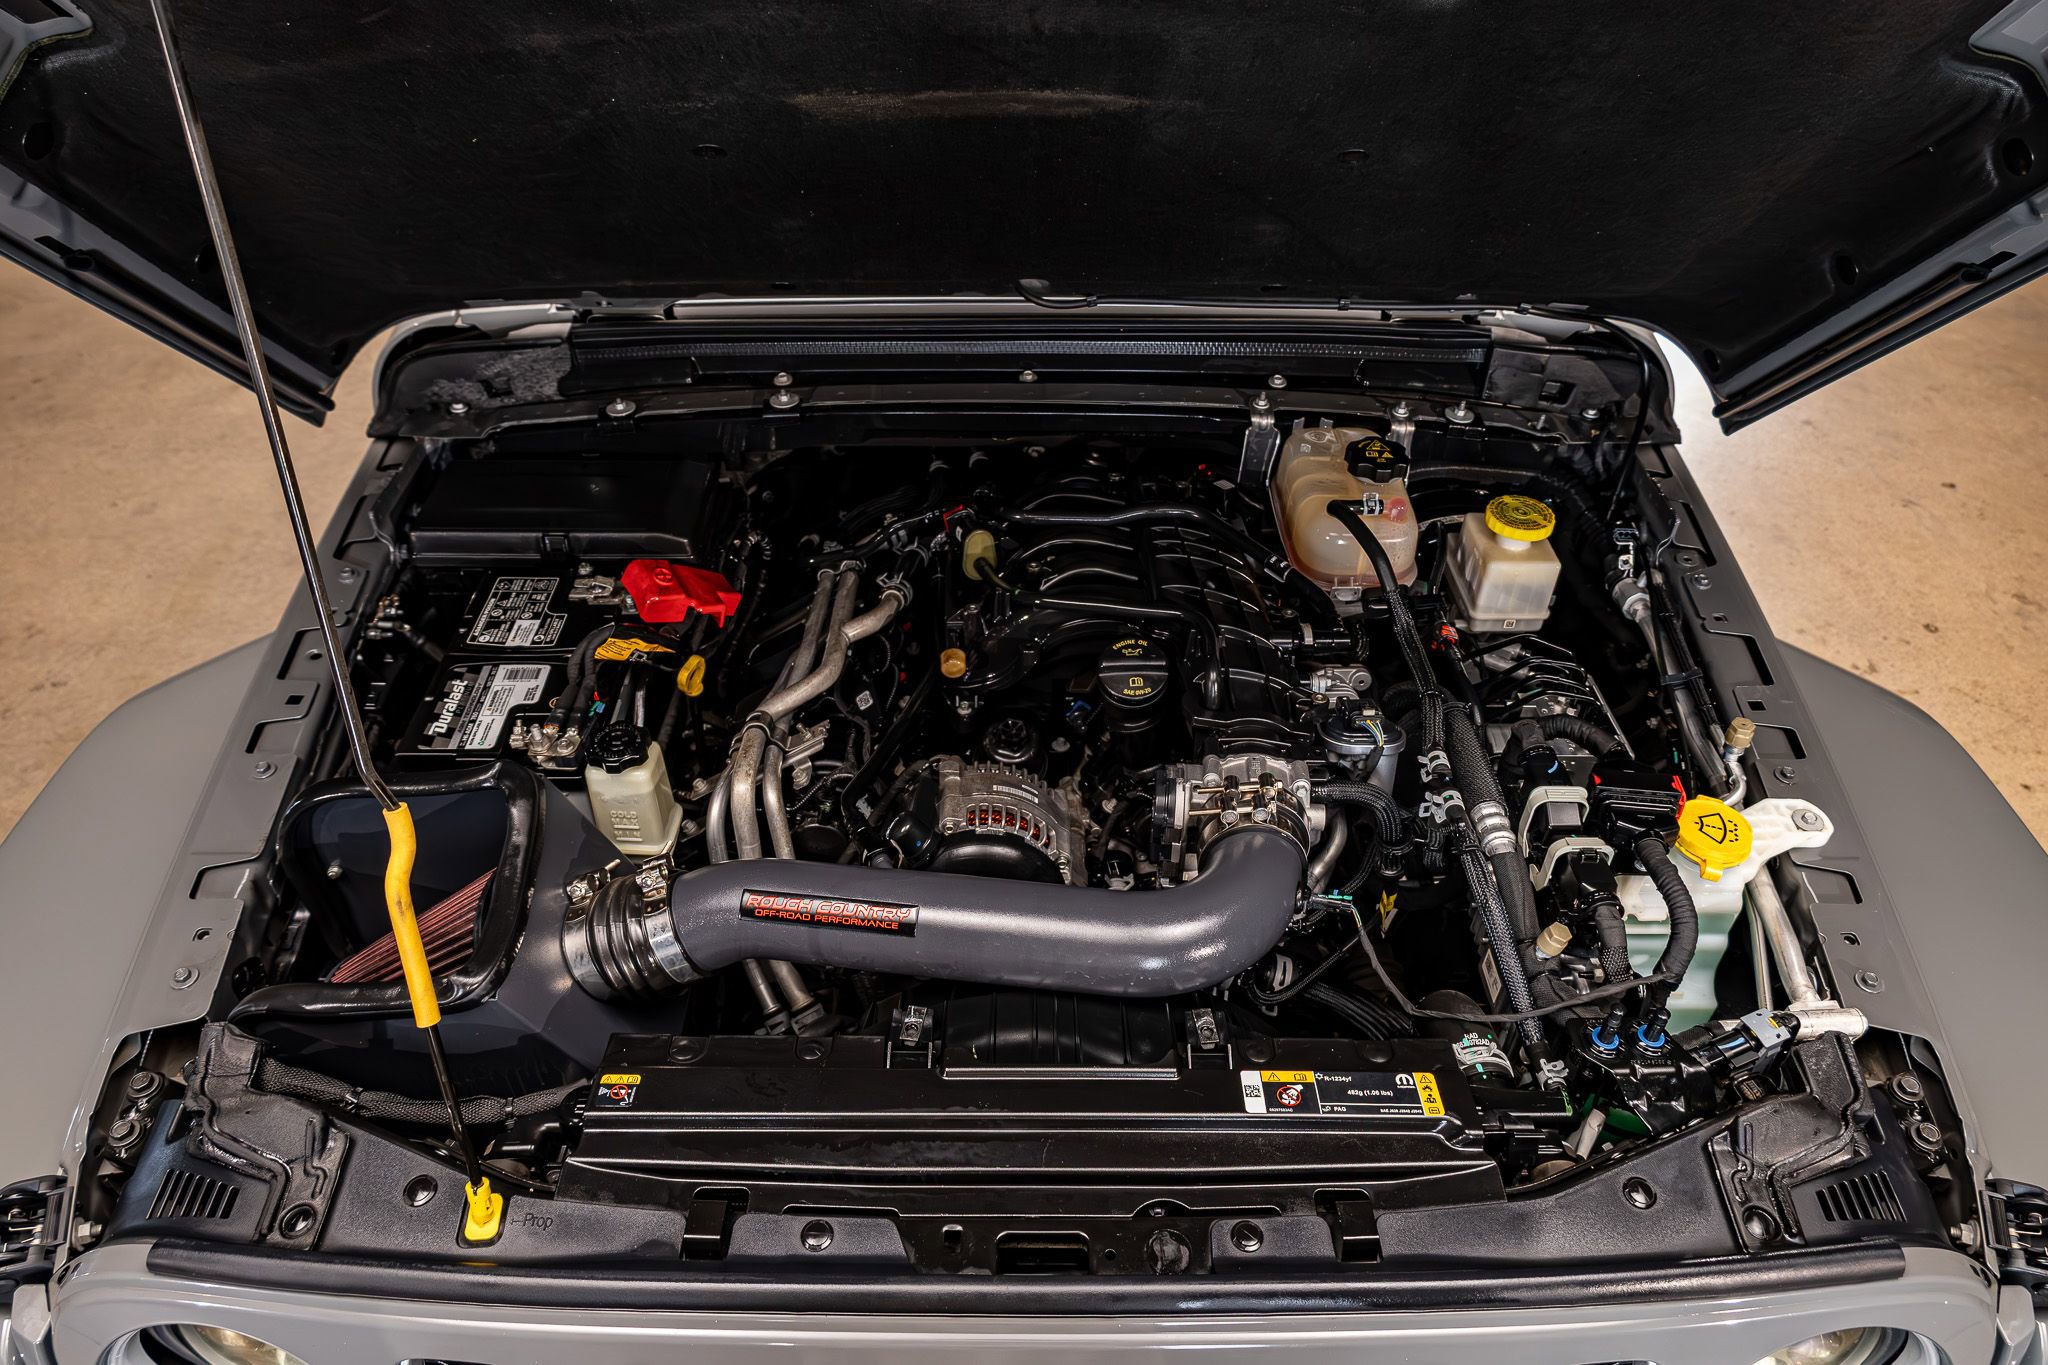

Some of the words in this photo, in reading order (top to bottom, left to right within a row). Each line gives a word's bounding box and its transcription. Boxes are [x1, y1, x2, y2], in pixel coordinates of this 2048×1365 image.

[1112, 639, 1135, 650] ENGINE
[428, 679, 469, 735] Duralast
[610, 810, 637, 818] COLD
[746, 894, 813, 912] ROUGH
[816, 901, 911, 921] COUNTRY
[754, 909, 811, 921] OFF-ROAD
[814, 915, 899, 930] PERFORMANCE
[523, 1212, 554, 1231] Prop
